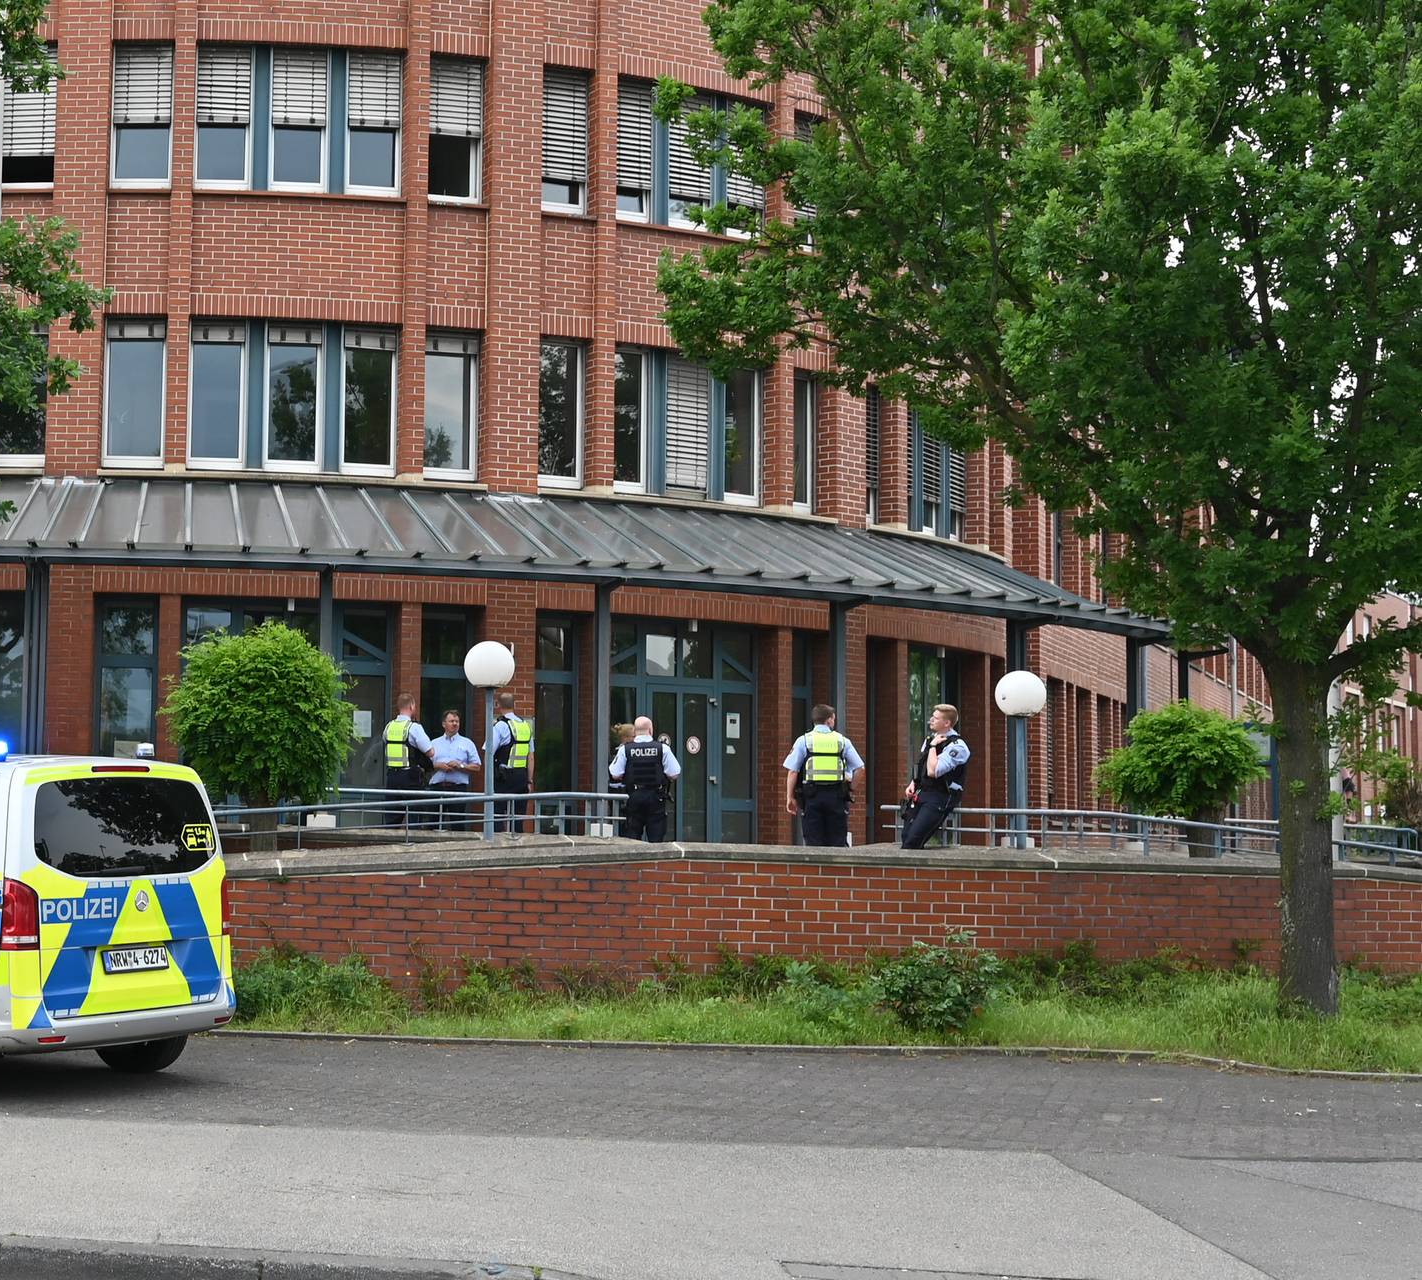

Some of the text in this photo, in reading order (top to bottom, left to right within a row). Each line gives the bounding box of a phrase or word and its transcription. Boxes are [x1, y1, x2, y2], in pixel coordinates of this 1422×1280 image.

[630, 748, 658, 757] POLIZEI
[43, 898, 117, 921] POLIZEI
[109, 951, 129, 968] NRW
